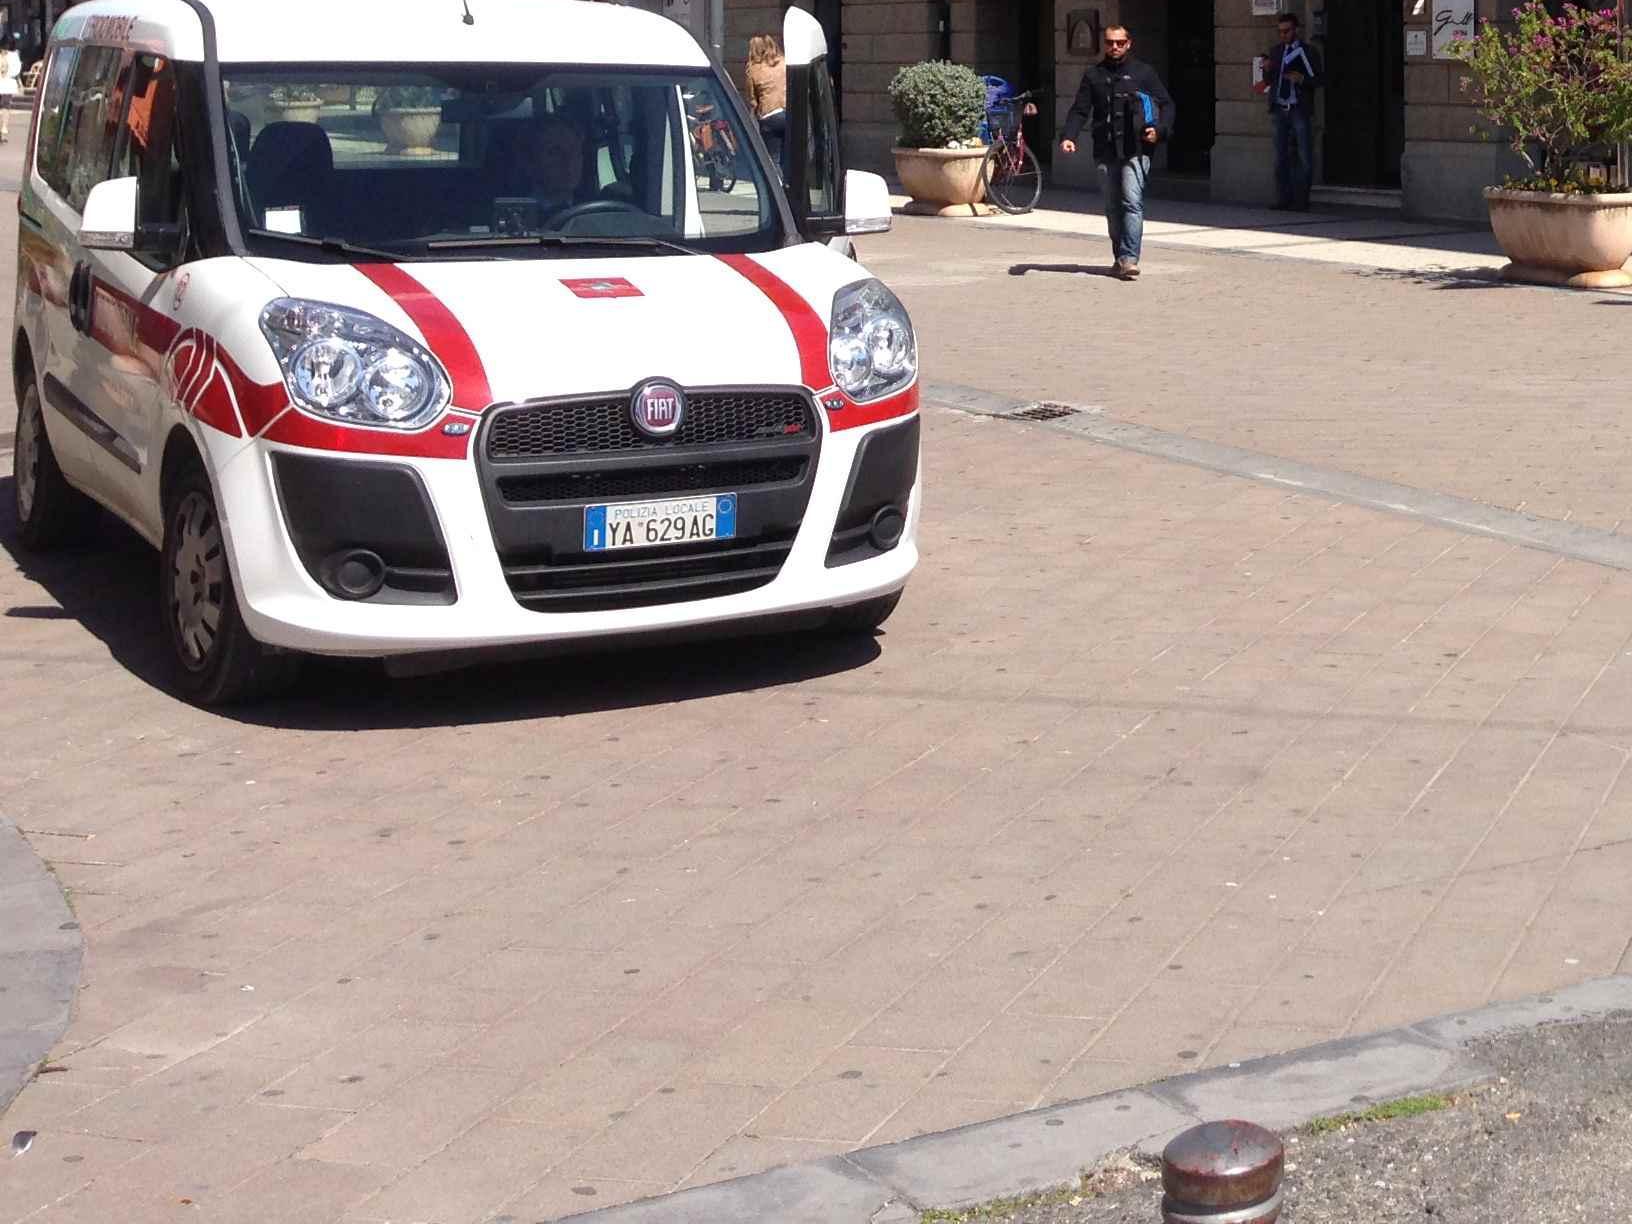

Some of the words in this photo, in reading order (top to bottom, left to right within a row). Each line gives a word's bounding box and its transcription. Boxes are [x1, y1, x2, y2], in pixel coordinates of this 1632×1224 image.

[646, 397, 675, 420] FIAT
[614, 506, 658, 520] POLIZIA
[664, 503, 709, 515] LOCALE
